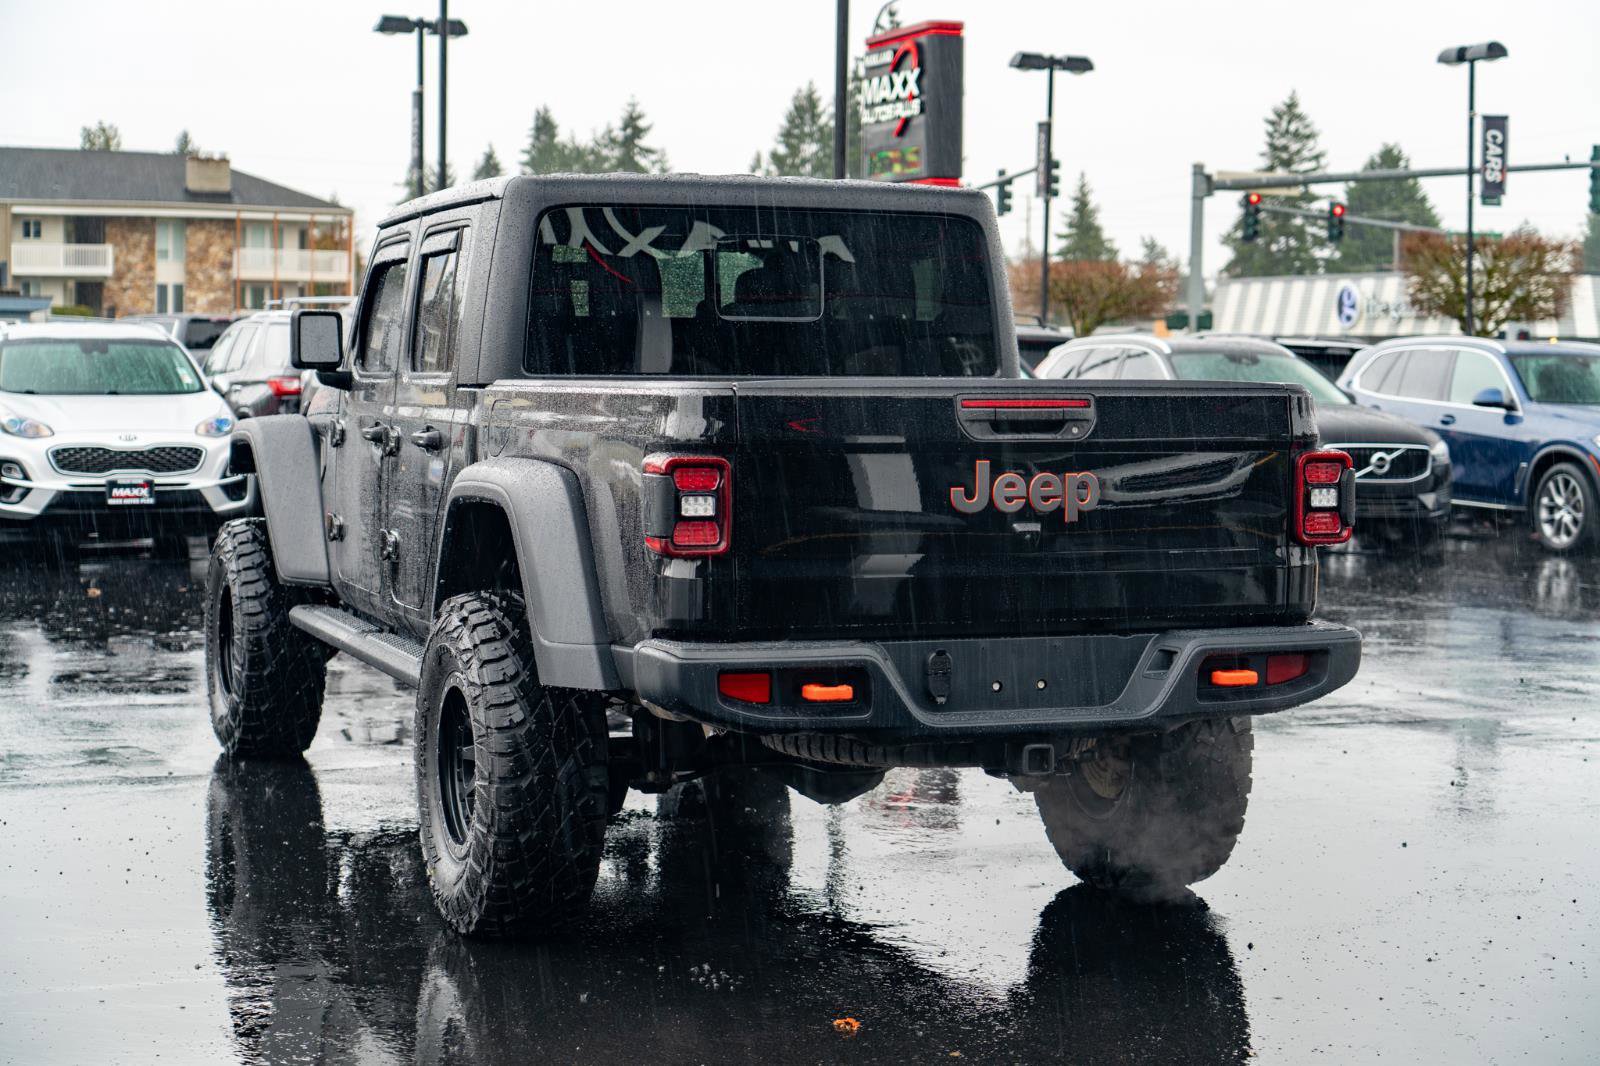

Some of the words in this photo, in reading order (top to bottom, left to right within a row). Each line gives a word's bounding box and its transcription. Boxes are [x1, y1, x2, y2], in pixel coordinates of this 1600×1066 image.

[861, 67, 920, 105] MAXX
[1485, 128, 1504, 183] CARS
[112, 487, 149, 497] MAXX
[950, 459, 1101, 523] Jeep
